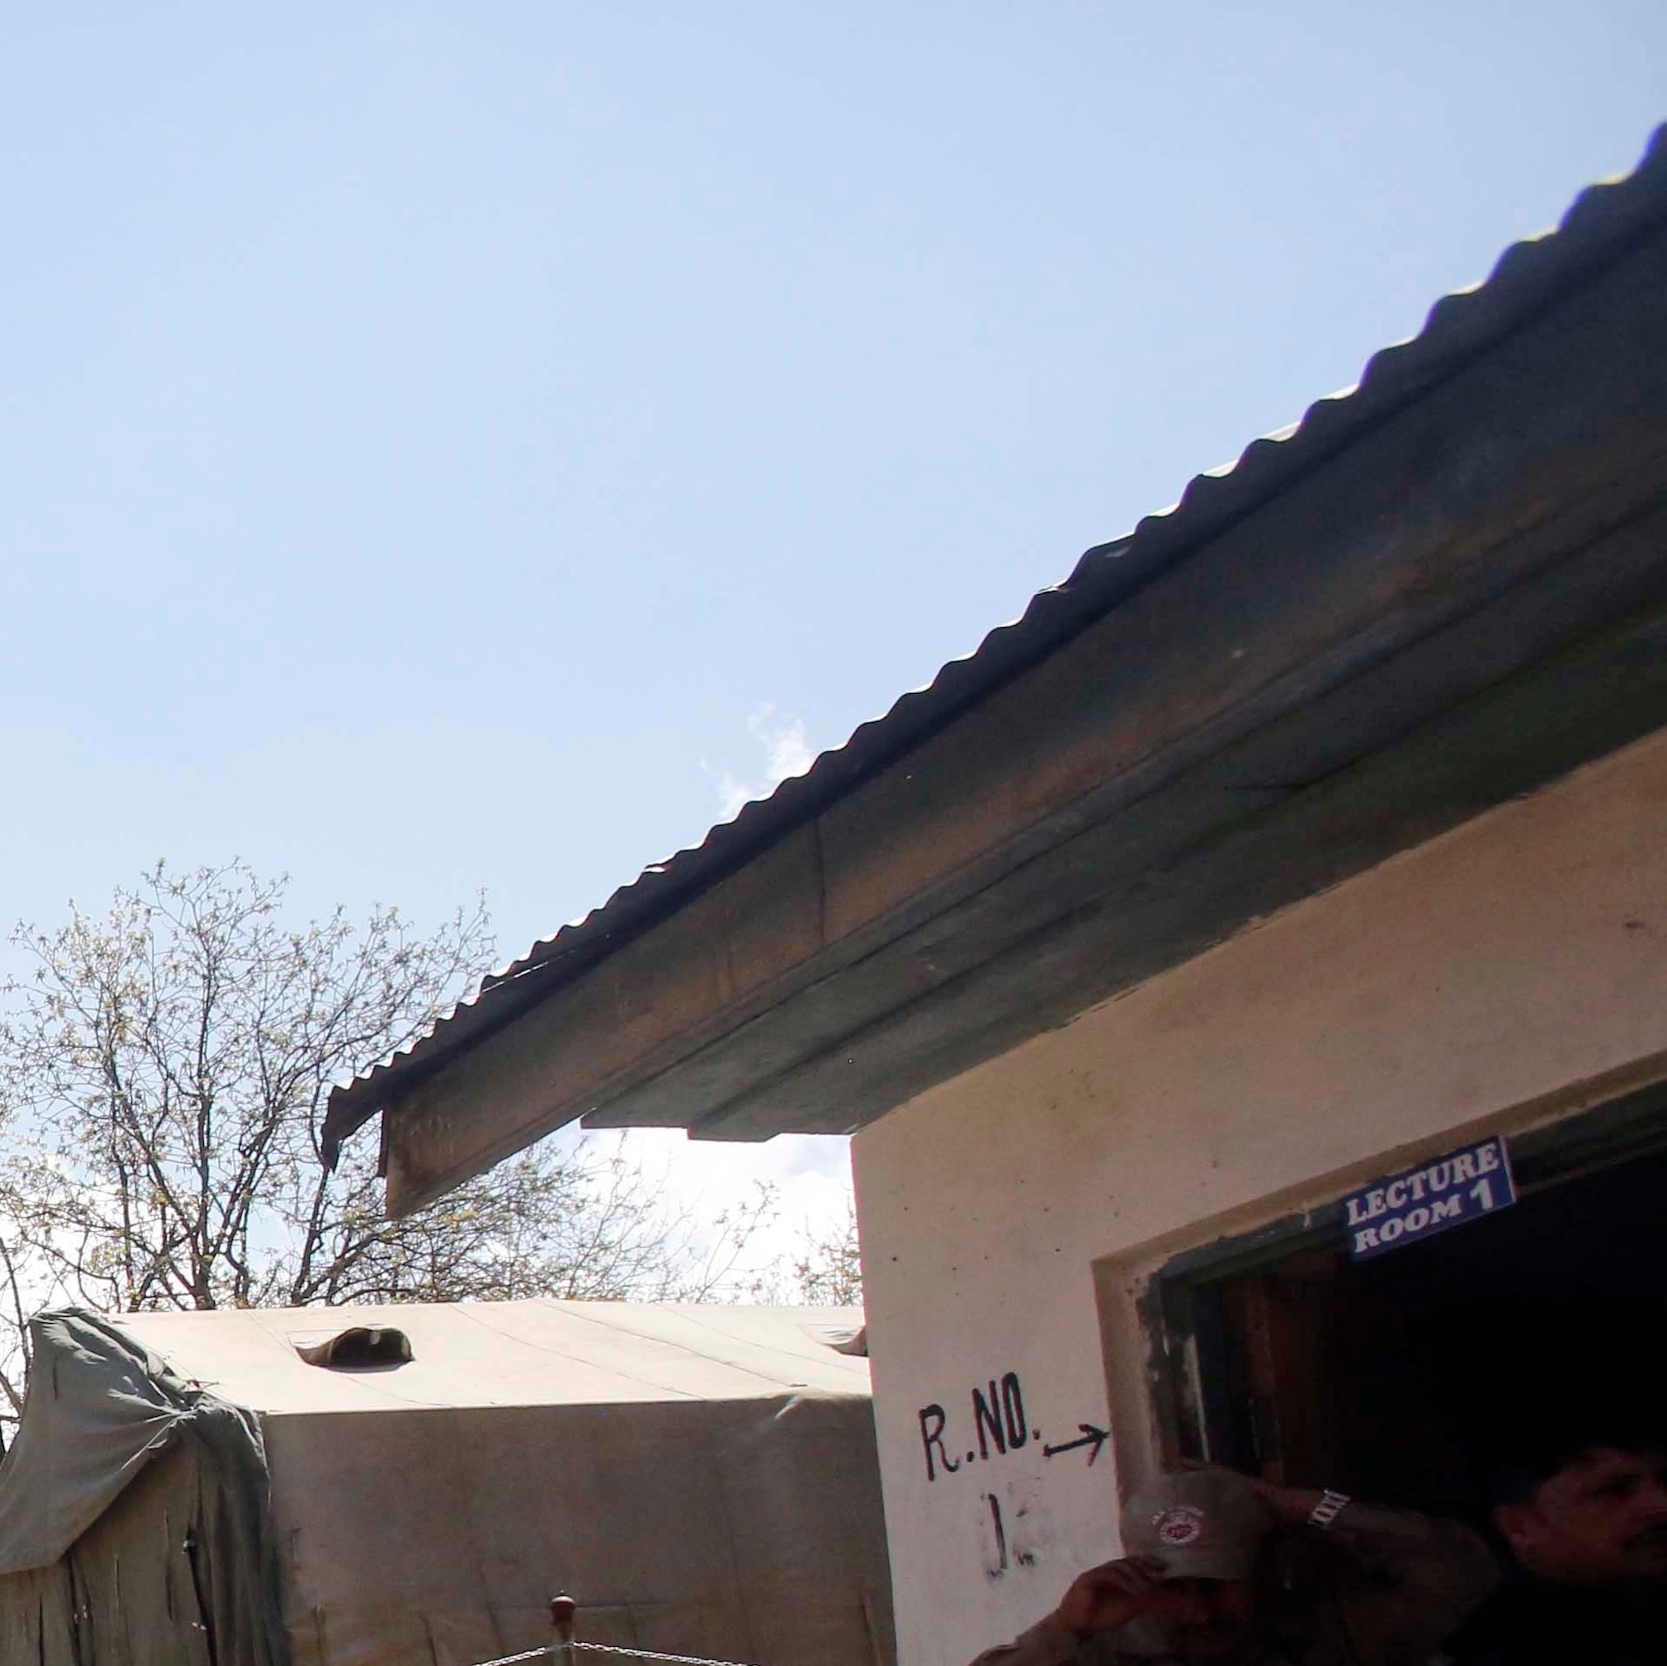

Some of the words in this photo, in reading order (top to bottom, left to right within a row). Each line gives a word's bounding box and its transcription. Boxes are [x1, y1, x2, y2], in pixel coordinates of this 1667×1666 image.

[1345, 1142, 1499, 1226] LECTURE
[1354, 1193, 1463, 1253] ROOM
[1469, 1178, 1494, 1211] 1
